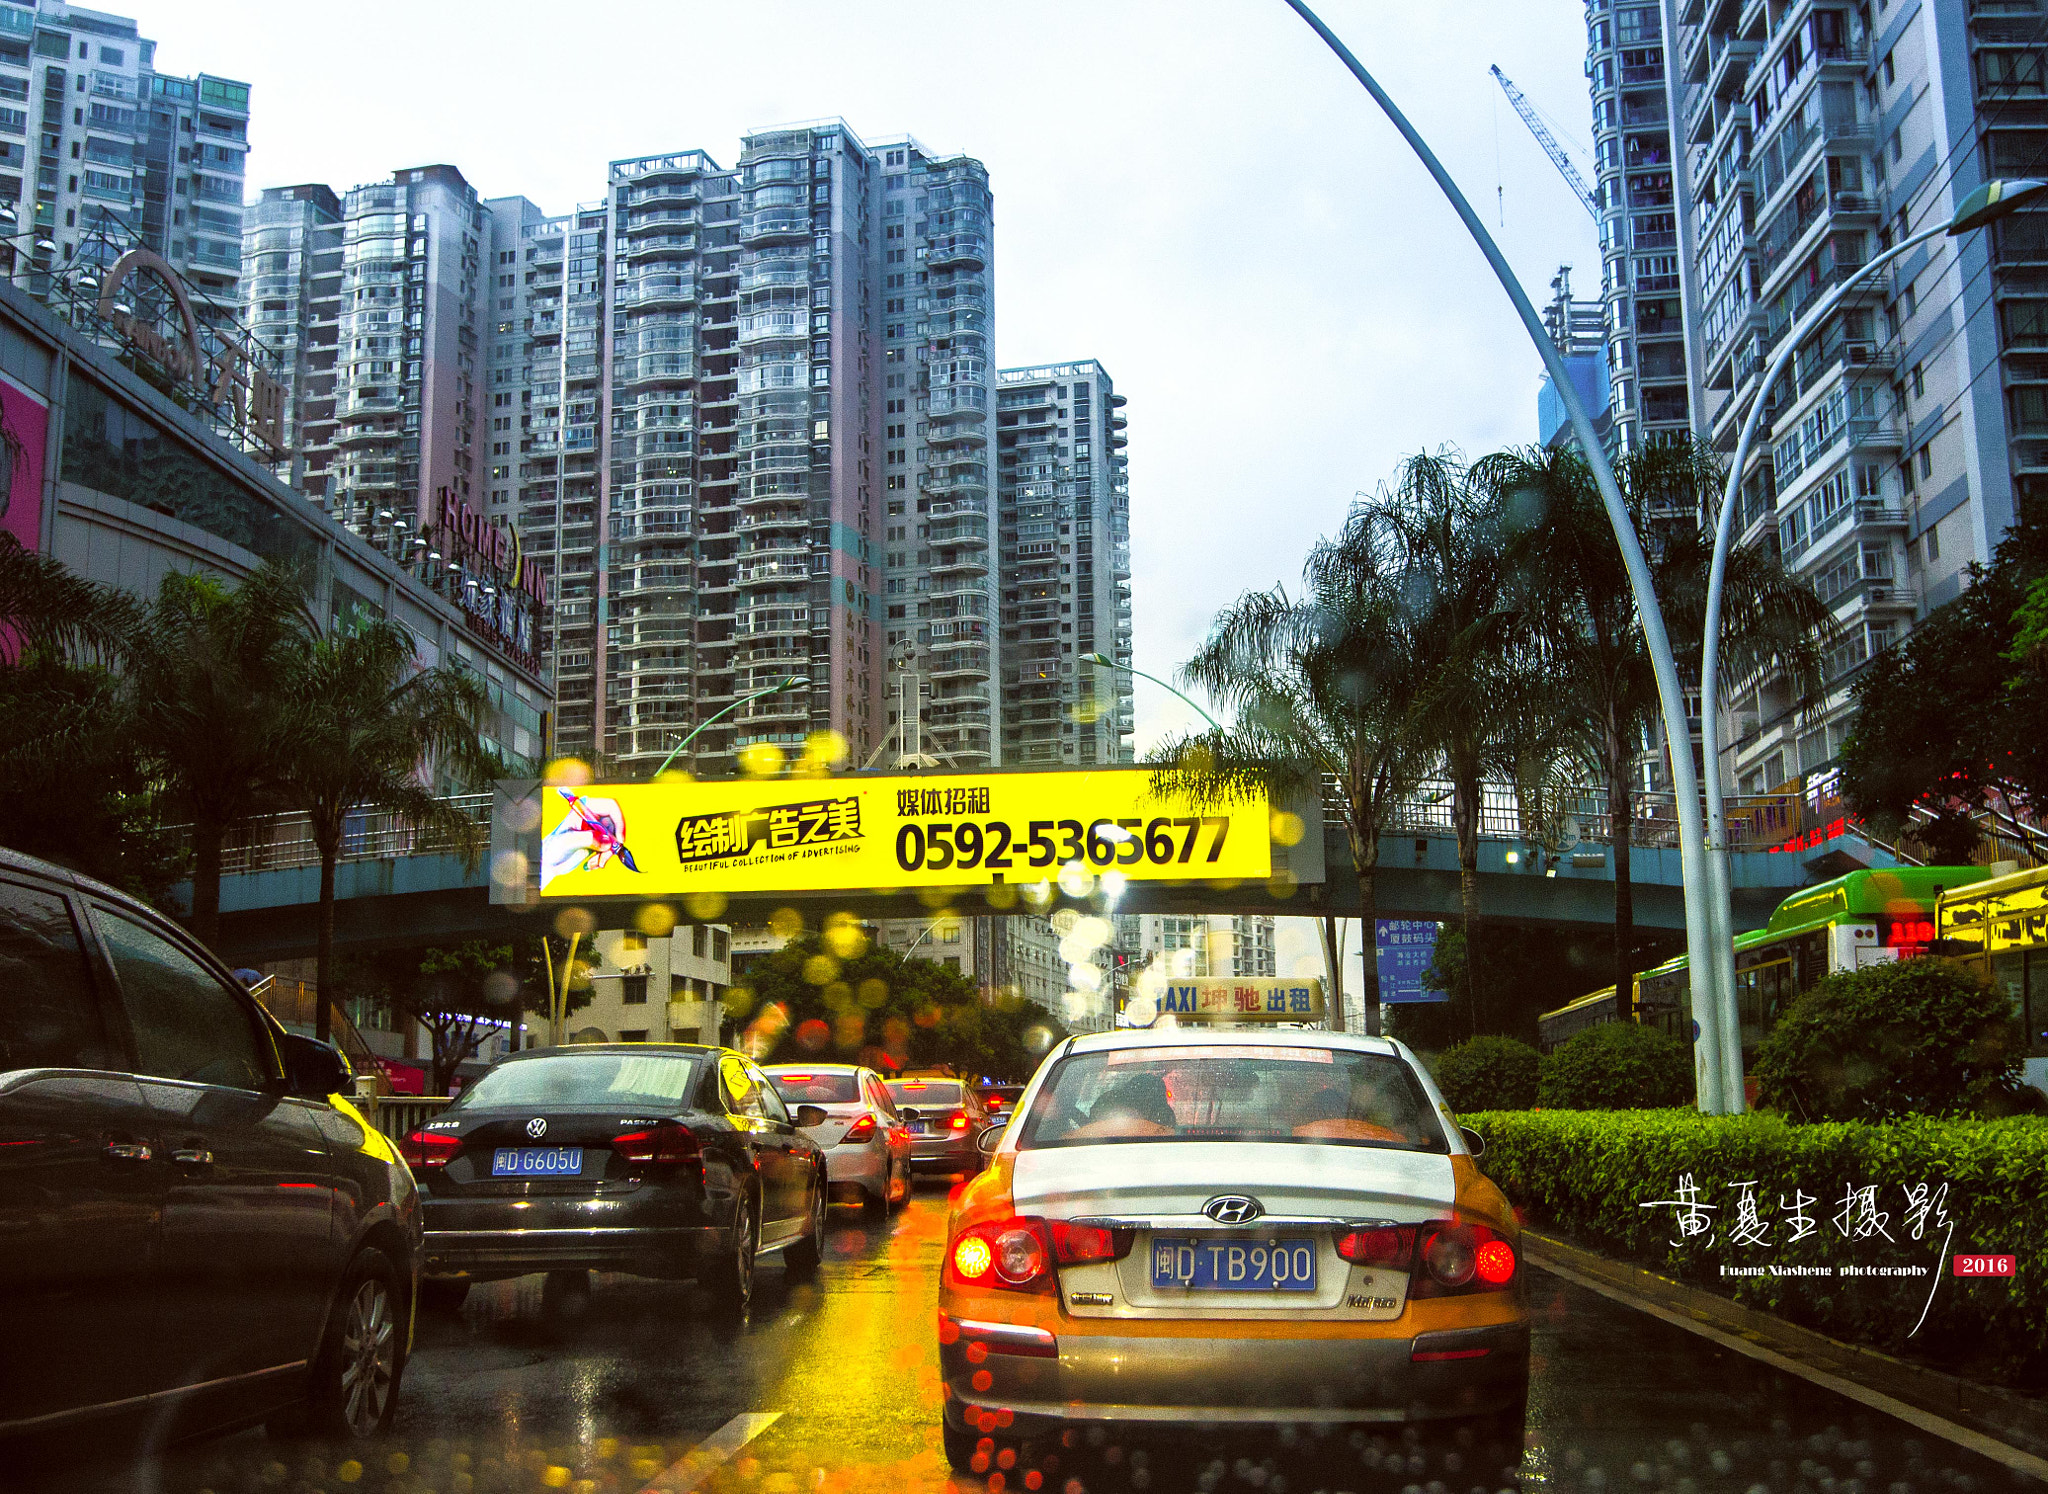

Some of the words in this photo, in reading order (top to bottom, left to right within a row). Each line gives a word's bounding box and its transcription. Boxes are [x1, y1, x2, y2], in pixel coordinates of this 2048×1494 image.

[443, 486, 507, 573] HOME
[897, 787, 990, 816] 媒体招租
[681, 800, 859, 858] 绘制广告之美
[896, 817, 1230, 871] 0592-5365677
[684, 859, 729, 873] BEAUTIFUL
[732, 852, 785, 867] COLLECTION
[788, 850, 800, 860] OF
[802, 845, 861, 859] ADVERTISING
[1388, 920, 1435, 931] 邮轮中心
[1390, 932, 1436, 944] 厦鼓码头
[1156, 987, 1197, 1012] TAXI
